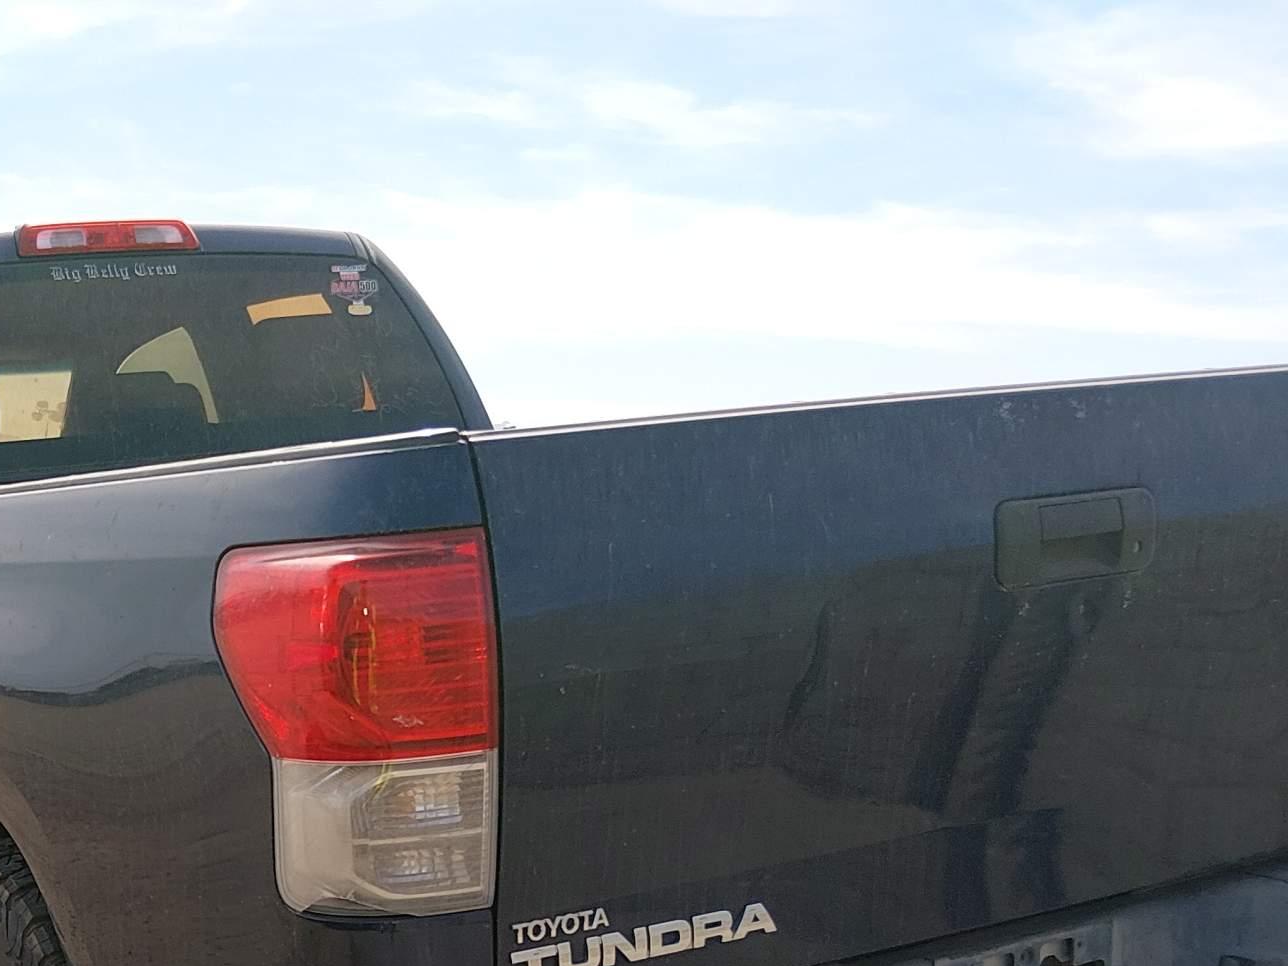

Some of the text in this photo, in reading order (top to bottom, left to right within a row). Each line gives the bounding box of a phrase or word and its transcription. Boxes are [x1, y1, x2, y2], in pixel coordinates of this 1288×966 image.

[50, 263, 177, 283] Big Belly Crew
[359, 280, 377, 293] 500
[512, 907, 609, 944] TOYOTA
